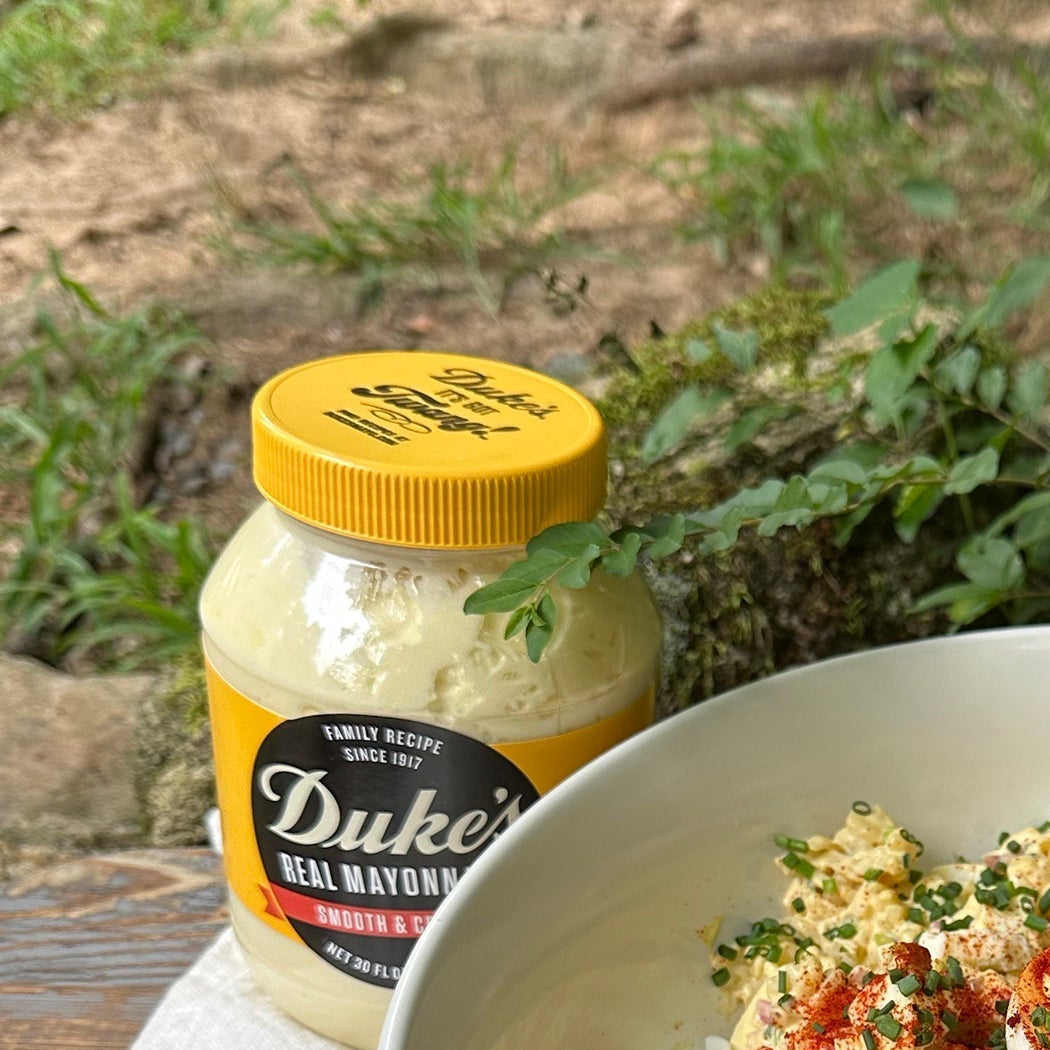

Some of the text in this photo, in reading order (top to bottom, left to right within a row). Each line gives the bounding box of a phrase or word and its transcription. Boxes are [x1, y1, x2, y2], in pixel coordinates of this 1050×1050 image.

[351, 384, 521, 440] Twang!
[429, 368, 560, 420] Duke's
[323, 724, 444, 755] FAMILY RECIPE
[343, 747, 423, 770] SINCE 1917
[278, 852, 469, 897] REAL MAYONN
[316, 904, 388, 933] SMOOTH
[394, 915, 408, 934] &
[324, 940, 405, 980] NET 30 FL O
